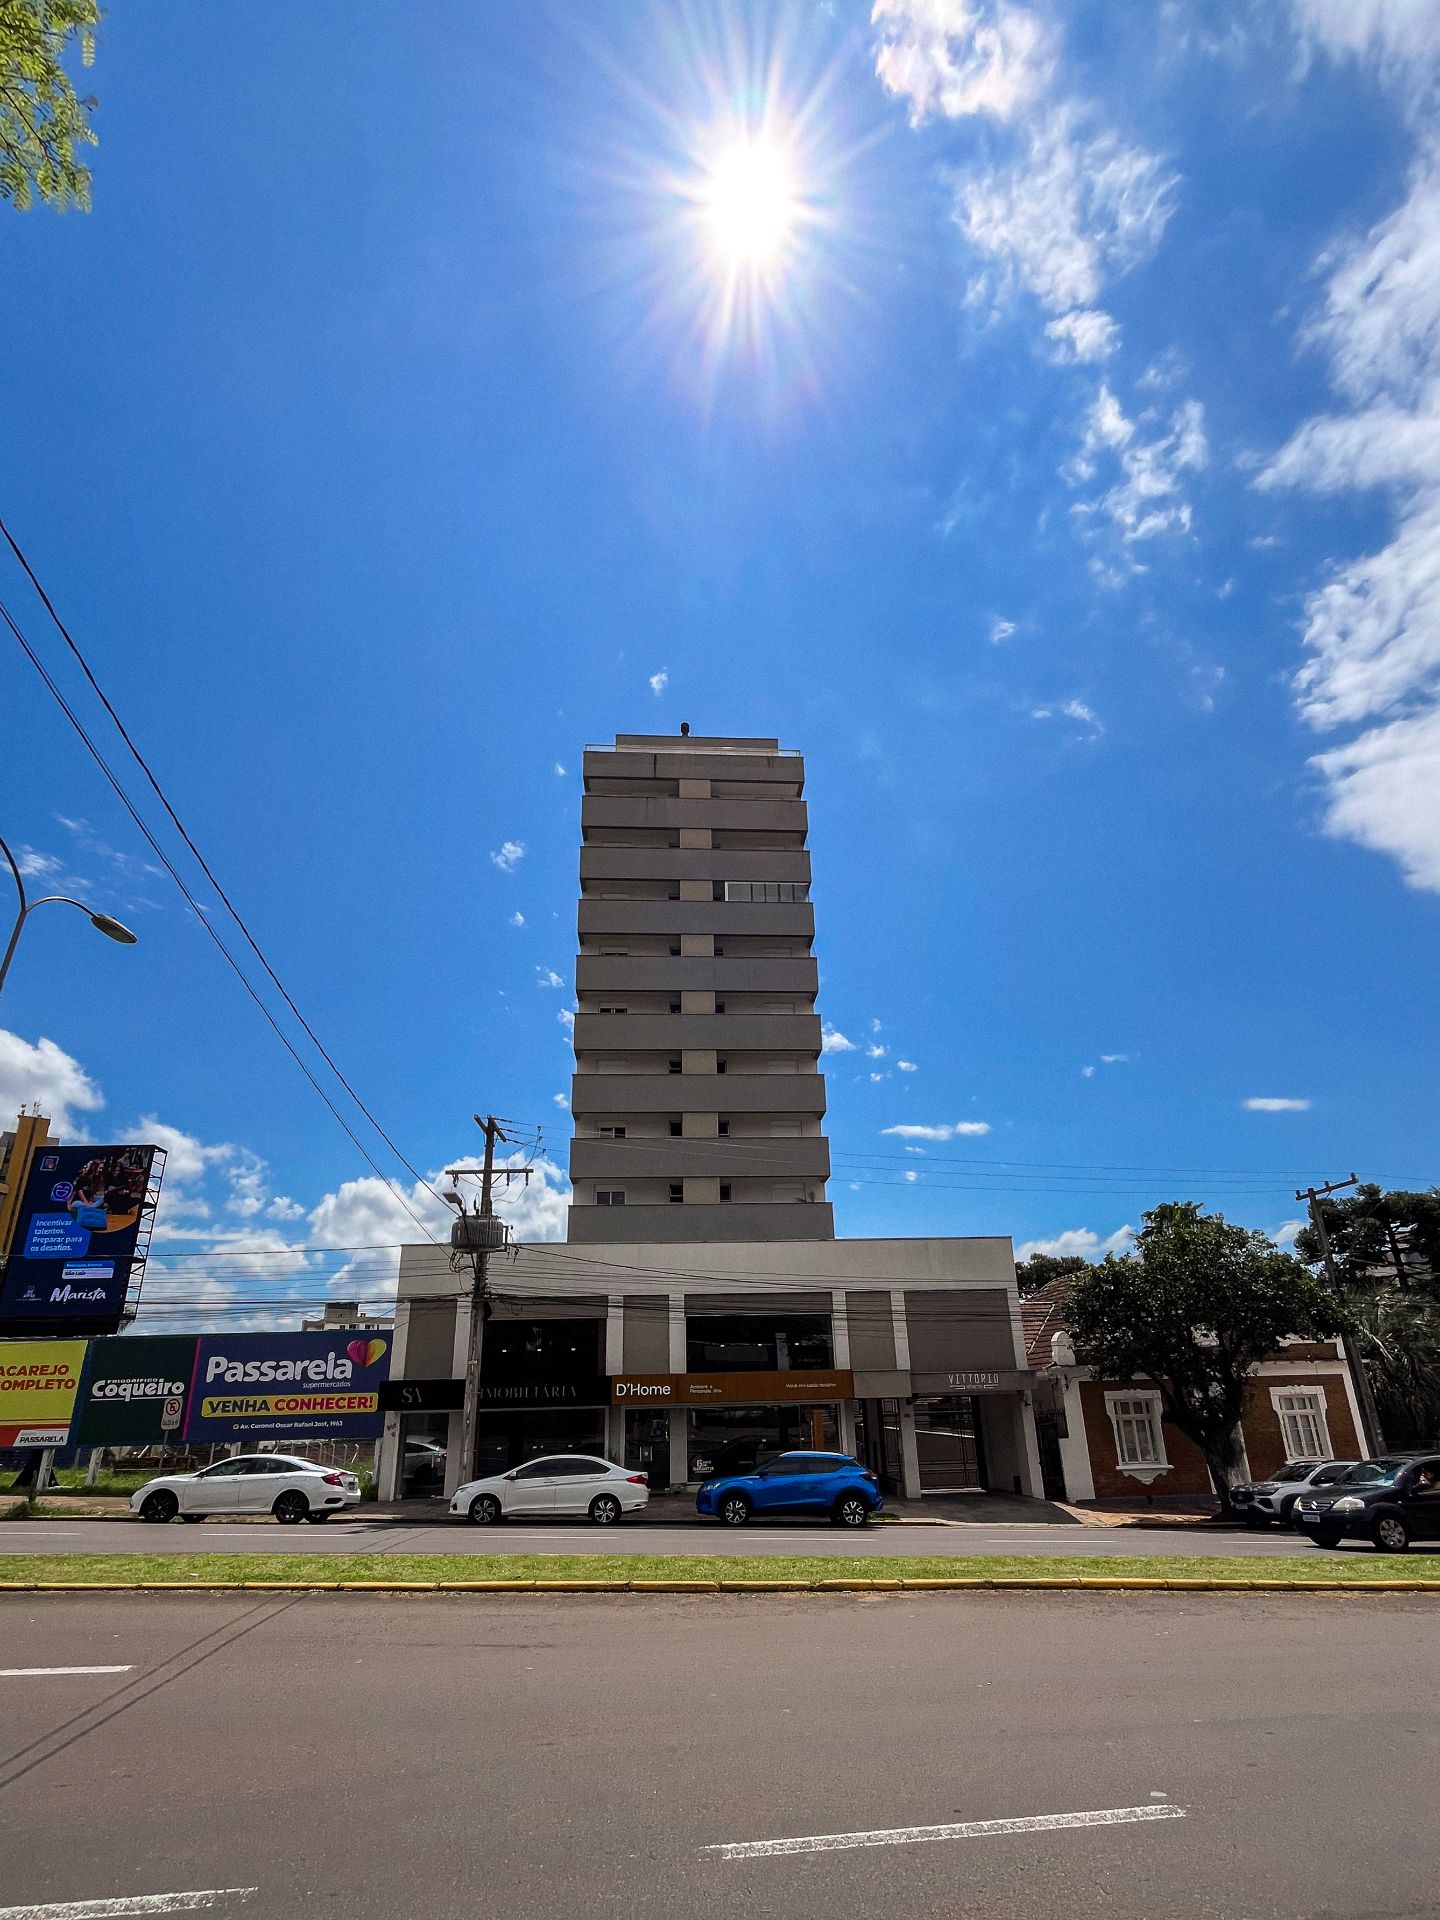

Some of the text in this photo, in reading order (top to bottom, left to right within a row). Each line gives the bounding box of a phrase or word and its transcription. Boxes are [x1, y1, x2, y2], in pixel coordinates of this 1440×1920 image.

[32, 1236, 64, 1244] Preparar
[50, 1285, 106, 1302] Marista
[206, 1351, 353, 1383] Passarela
[0, 1378, 76, 1391] OMPLETO
[949, 1374, 999, 1384] VITTORIO
[92, 1379, 185, 1401] Coqueiro
[616, 1383, 671, 1396] D'Home
[208, 1396, 374, 1413] VENHA CONHECER!
